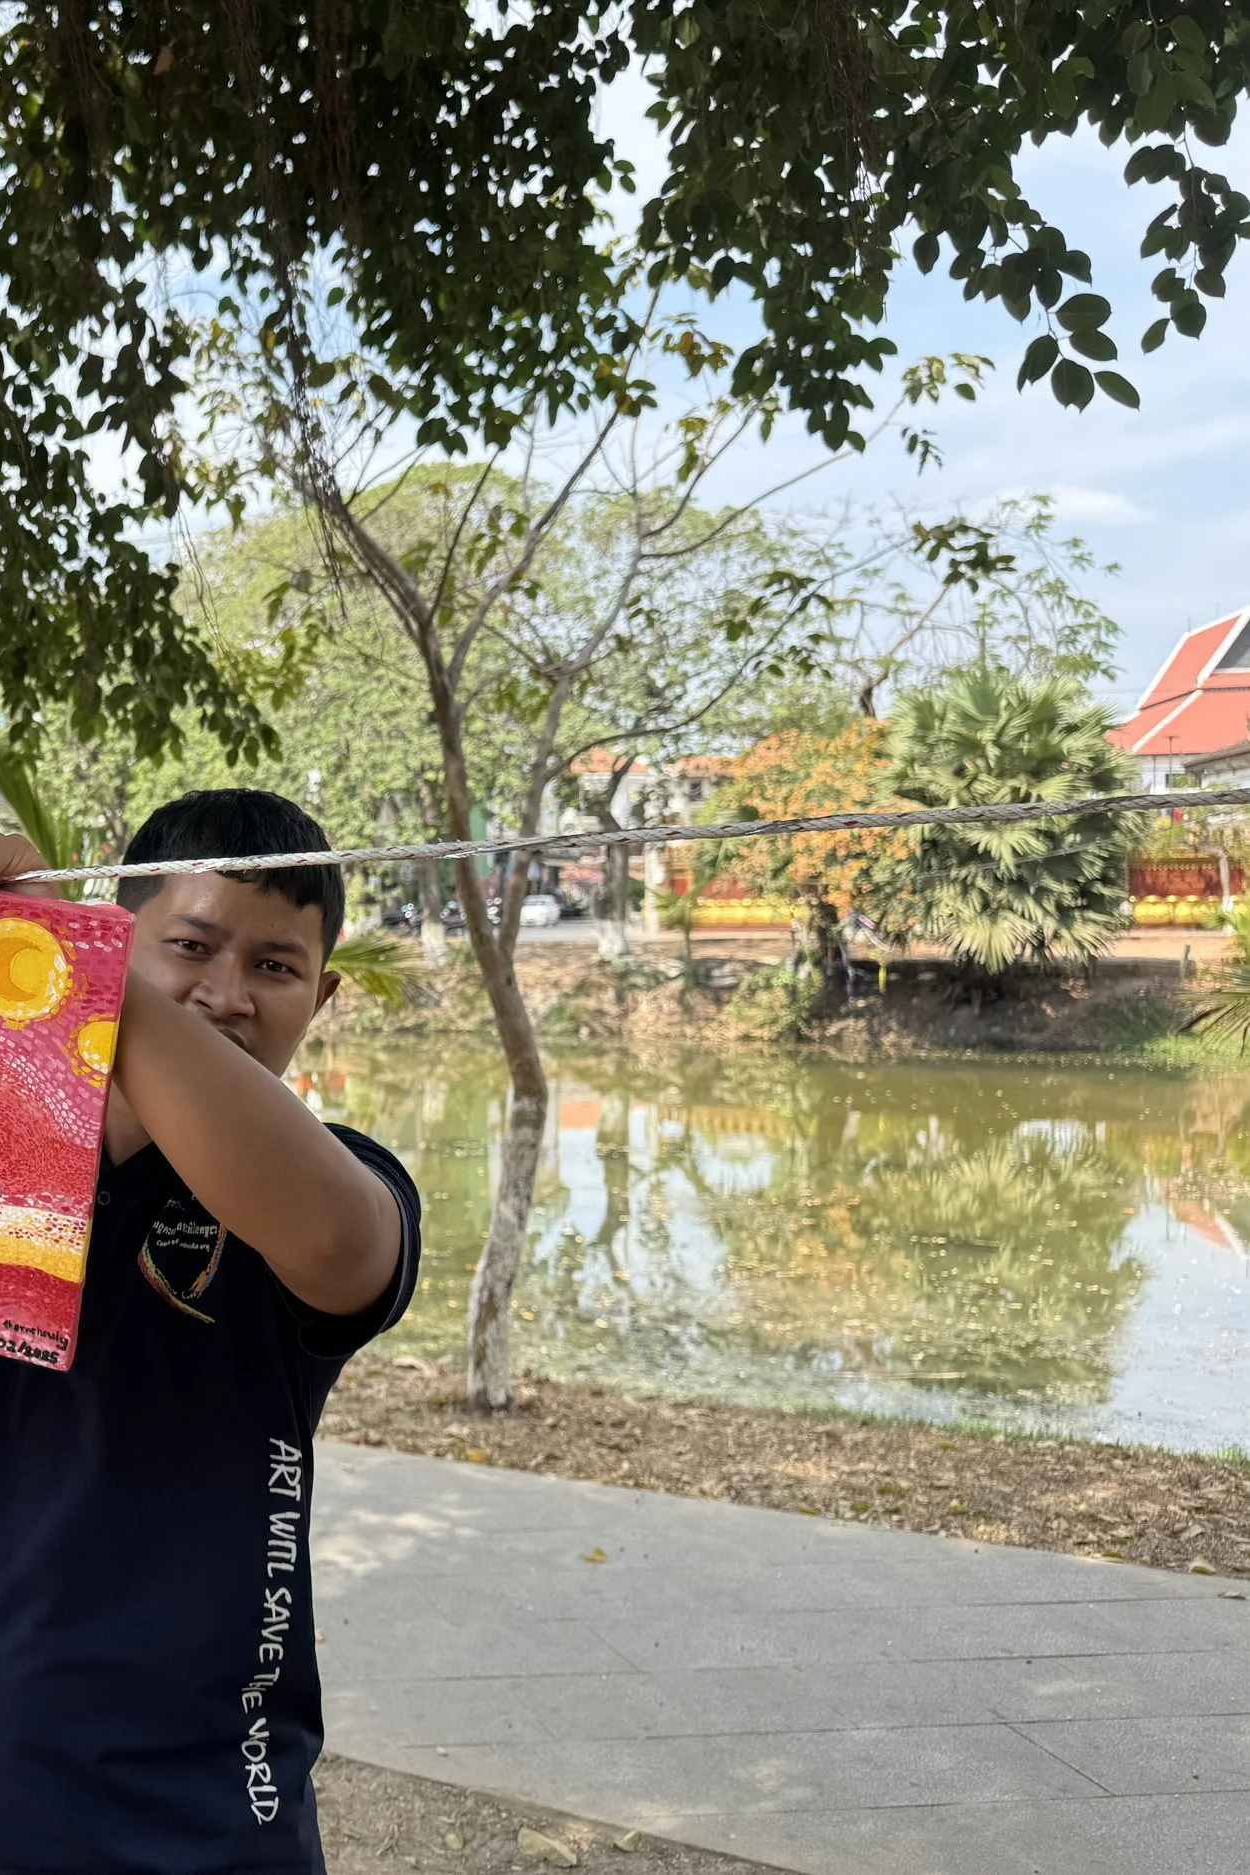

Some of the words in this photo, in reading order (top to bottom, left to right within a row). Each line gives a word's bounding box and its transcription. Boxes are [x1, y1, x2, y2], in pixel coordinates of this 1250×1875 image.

[267, 1437, 302, 1502] ART
[258, 1586, 292, 1664] SAVE
[241, 1666, 281, 1714] THE
[241, 1717, 280, 1825] WORLD
